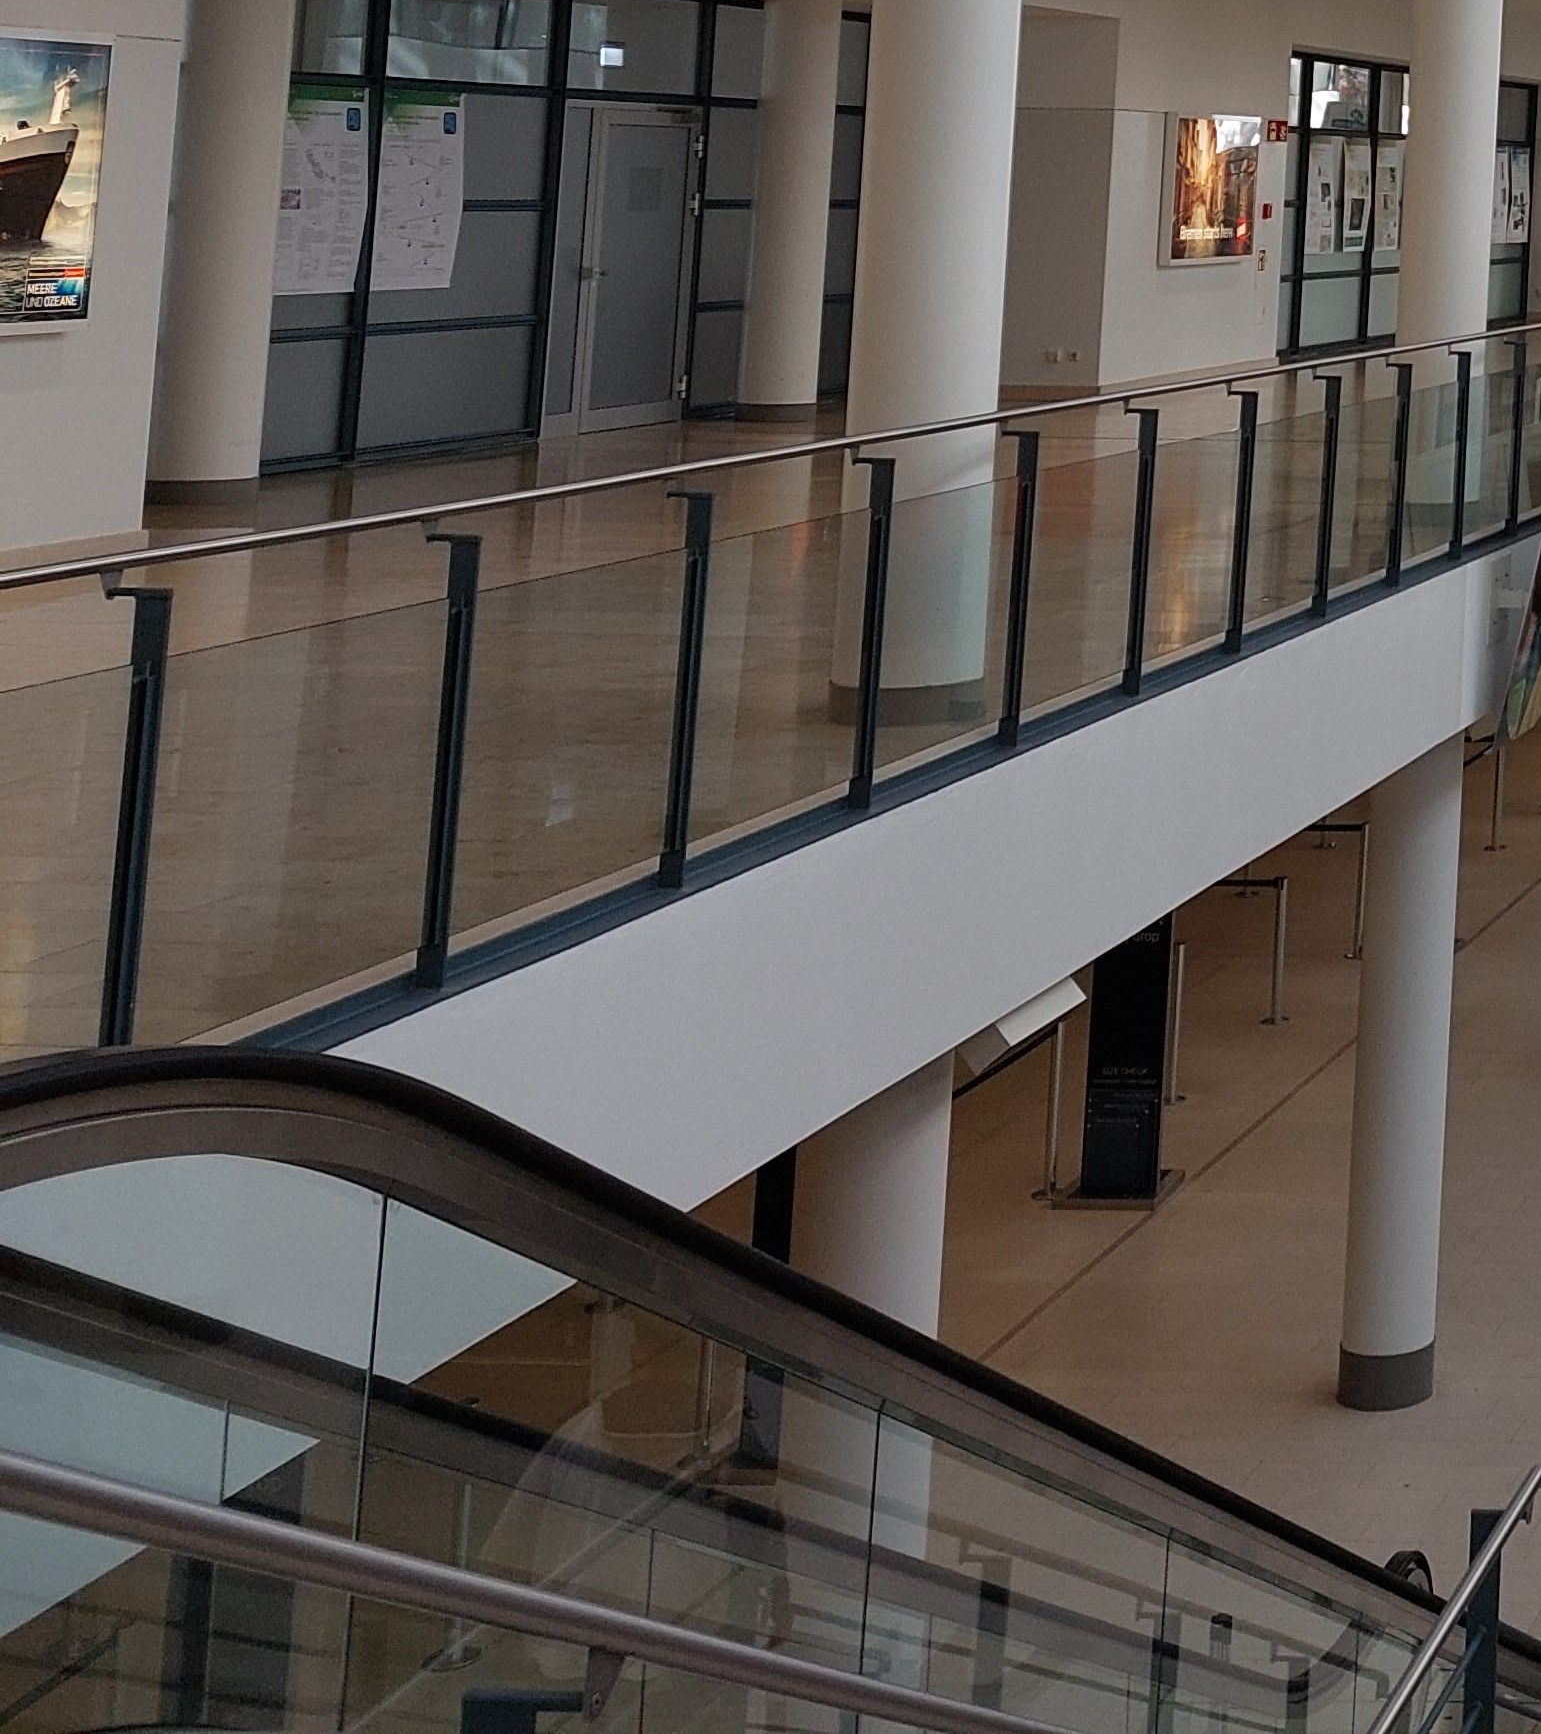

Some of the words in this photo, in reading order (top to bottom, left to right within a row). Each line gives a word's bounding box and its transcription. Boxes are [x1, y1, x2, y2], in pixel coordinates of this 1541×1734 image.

[27, 282, 58, 295] MEERE
[26, 296, 43, 308] UND
[44, 294, 79, 307] OZEANE
